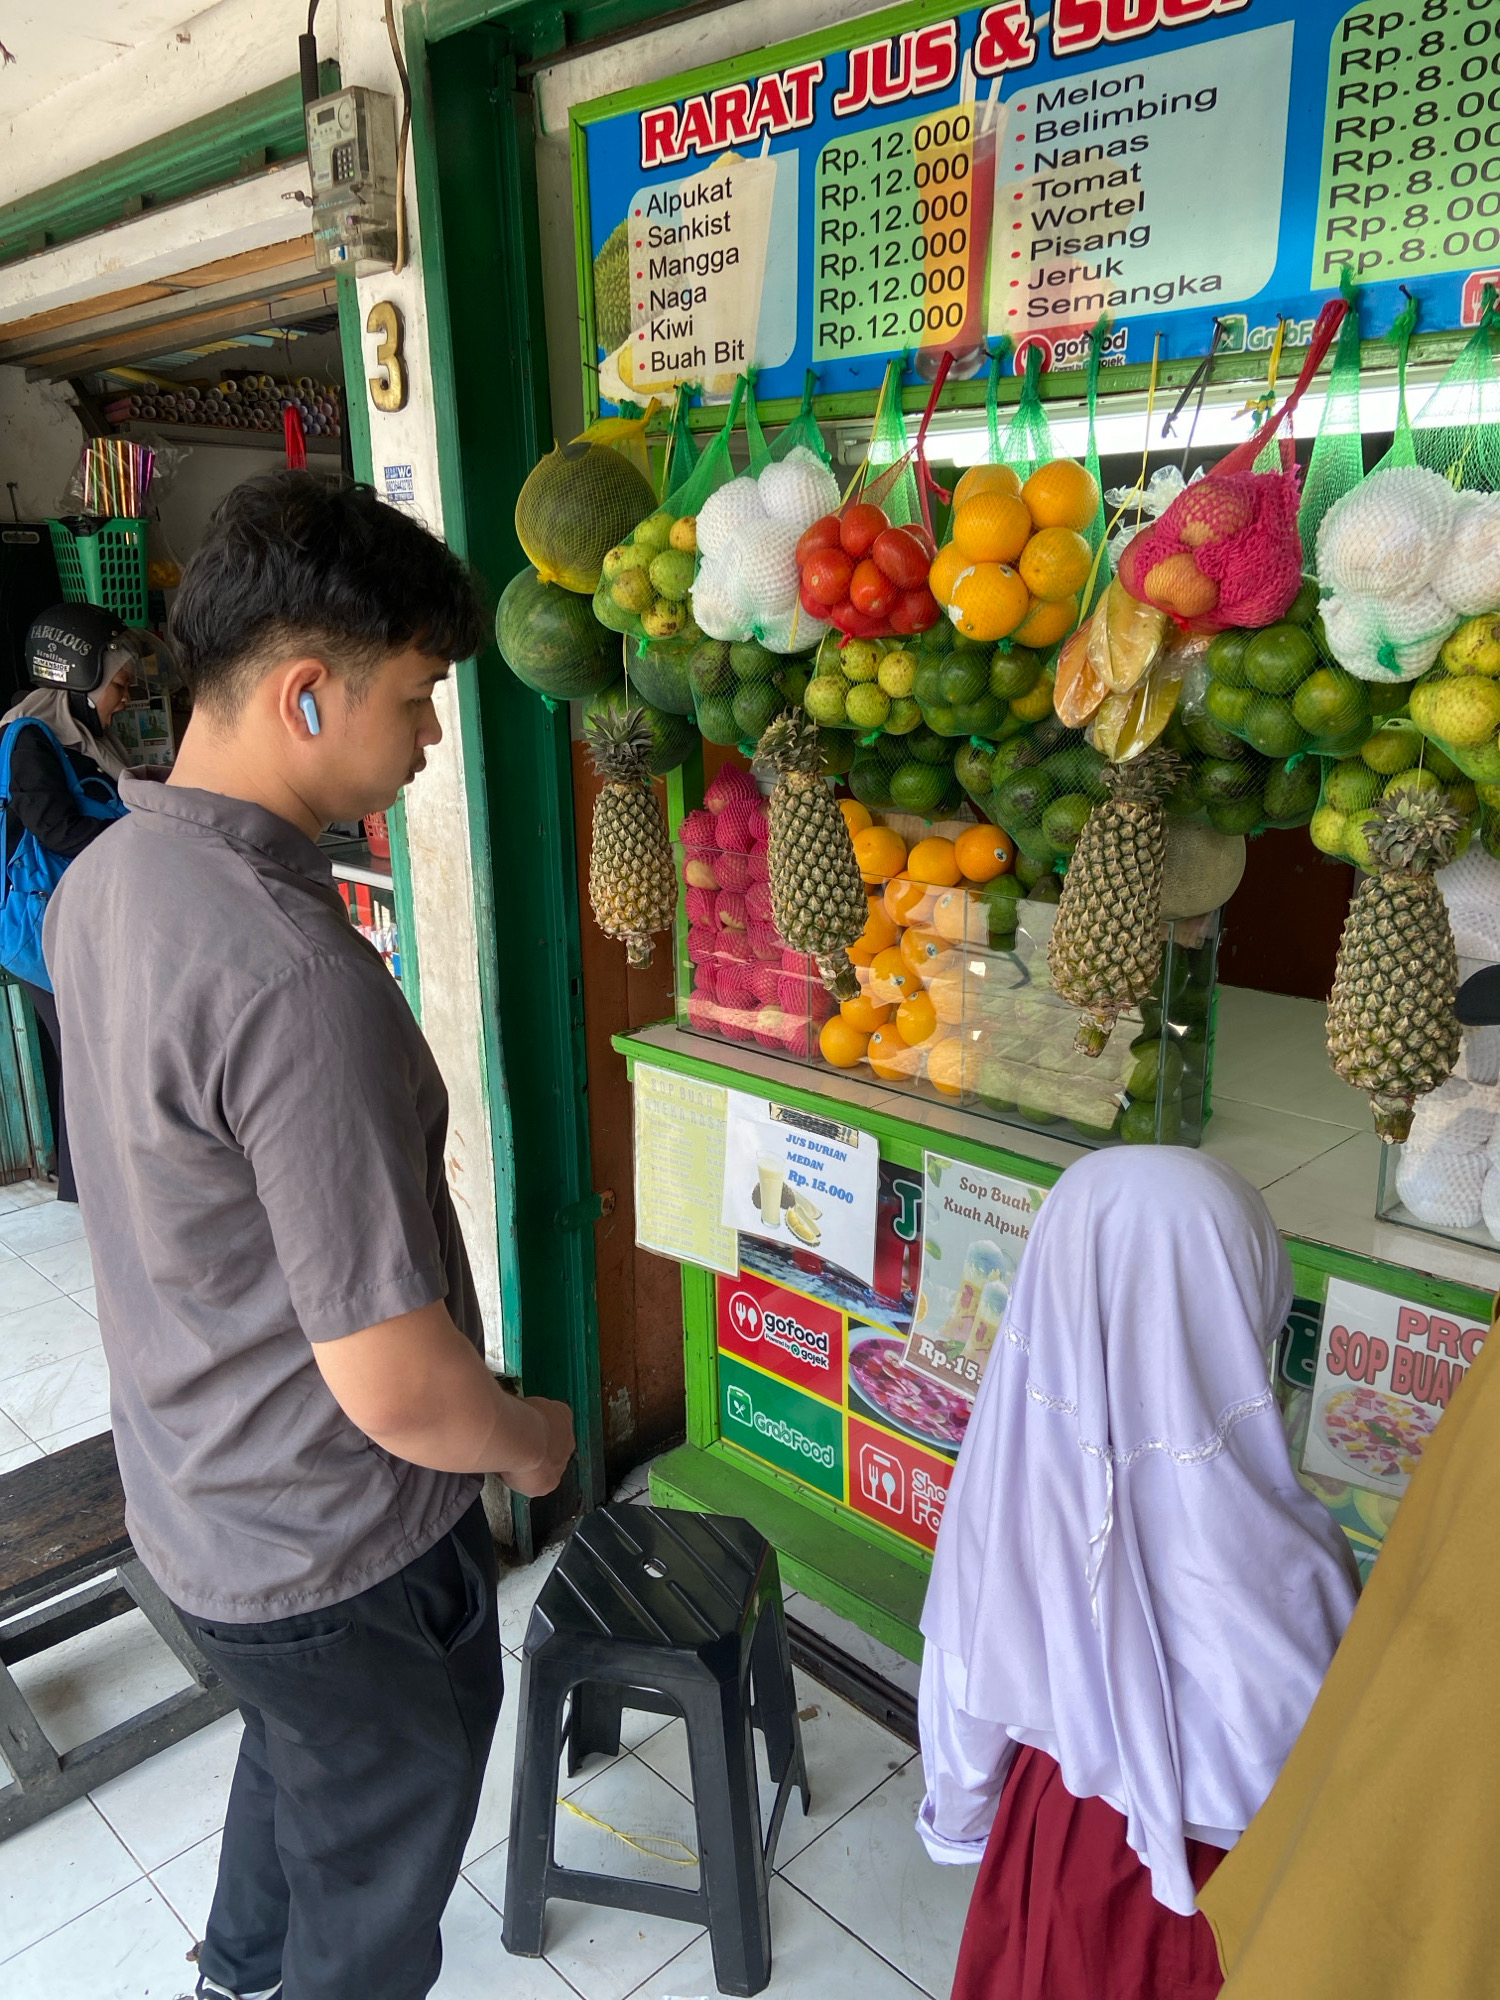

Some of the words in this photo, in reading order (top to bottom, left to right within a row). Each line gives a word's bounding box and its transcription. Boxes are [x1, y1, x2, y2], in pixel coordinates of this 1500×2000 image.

[1340, 19, 1500, 76] Rp.8.0
[643, 62, 822, 166] RARAT
[835, 23, 955, 114] JUS
[977, 1, 1034, 72] &
[1036, 74, 1144, 114] Melon
[1035, 87, 1217, 144] Belimbing
[821, 115, 970, 176] Rp.12.000
[1034, 134, 1149, 173] Nanas
[646, 177, 733, 218] Alpukat
[821, 153, 969, 211] Rp.12.000
[1032, 162, 1142, 201] Tomat
[648, 210, 731, 248] Sankist
[821, 190, 968, 246] Rp.12.000
[1031, 191, 1145, 231] Wortel
[820, 228, 967, 281] Rp.12.000
[1030, 225, 1151, 261] Pisang
[649, 246, 740, 280] Mangga
[1027, 257, 1124, 290] Jeruk
[650, 286, 707, 311] Naga
[820, 265, 965, 315] Rp.12.000
[1026, 275, 1222, 318] Semangka
[651, 315, 693, 342] Kiwi
[819, 302, 963, 349] Rp.12.000
[367, 300, 409, 412] 3
[651, 346, 706, 372] Buah
[714, 339, 745, 364] Bit
[1054, 328, 1127, 363] gofod
[398, 465, 412, 478] WC
[31, 625, 92, 656] FABULOUS
[785, 1133, 806, 1148] JUS
[807, 1140, 848, 1162] DURIAN
[787, 1151, 824, 1171] MEDAN
[944, 1196, 981, 1222] Kuah
[959, 1176, 988, 1200] Sop
[991, 1186, 1031, 1214] Buah
[763, 1312, 829, 1354] gofood
[800, 1349, 828, 1368] gojek
[1326, 1325, 1389, 1386] SOP
[754, 1411, 834, 1468] GrabFood
[912, 1468, 948, 1505] Sho
